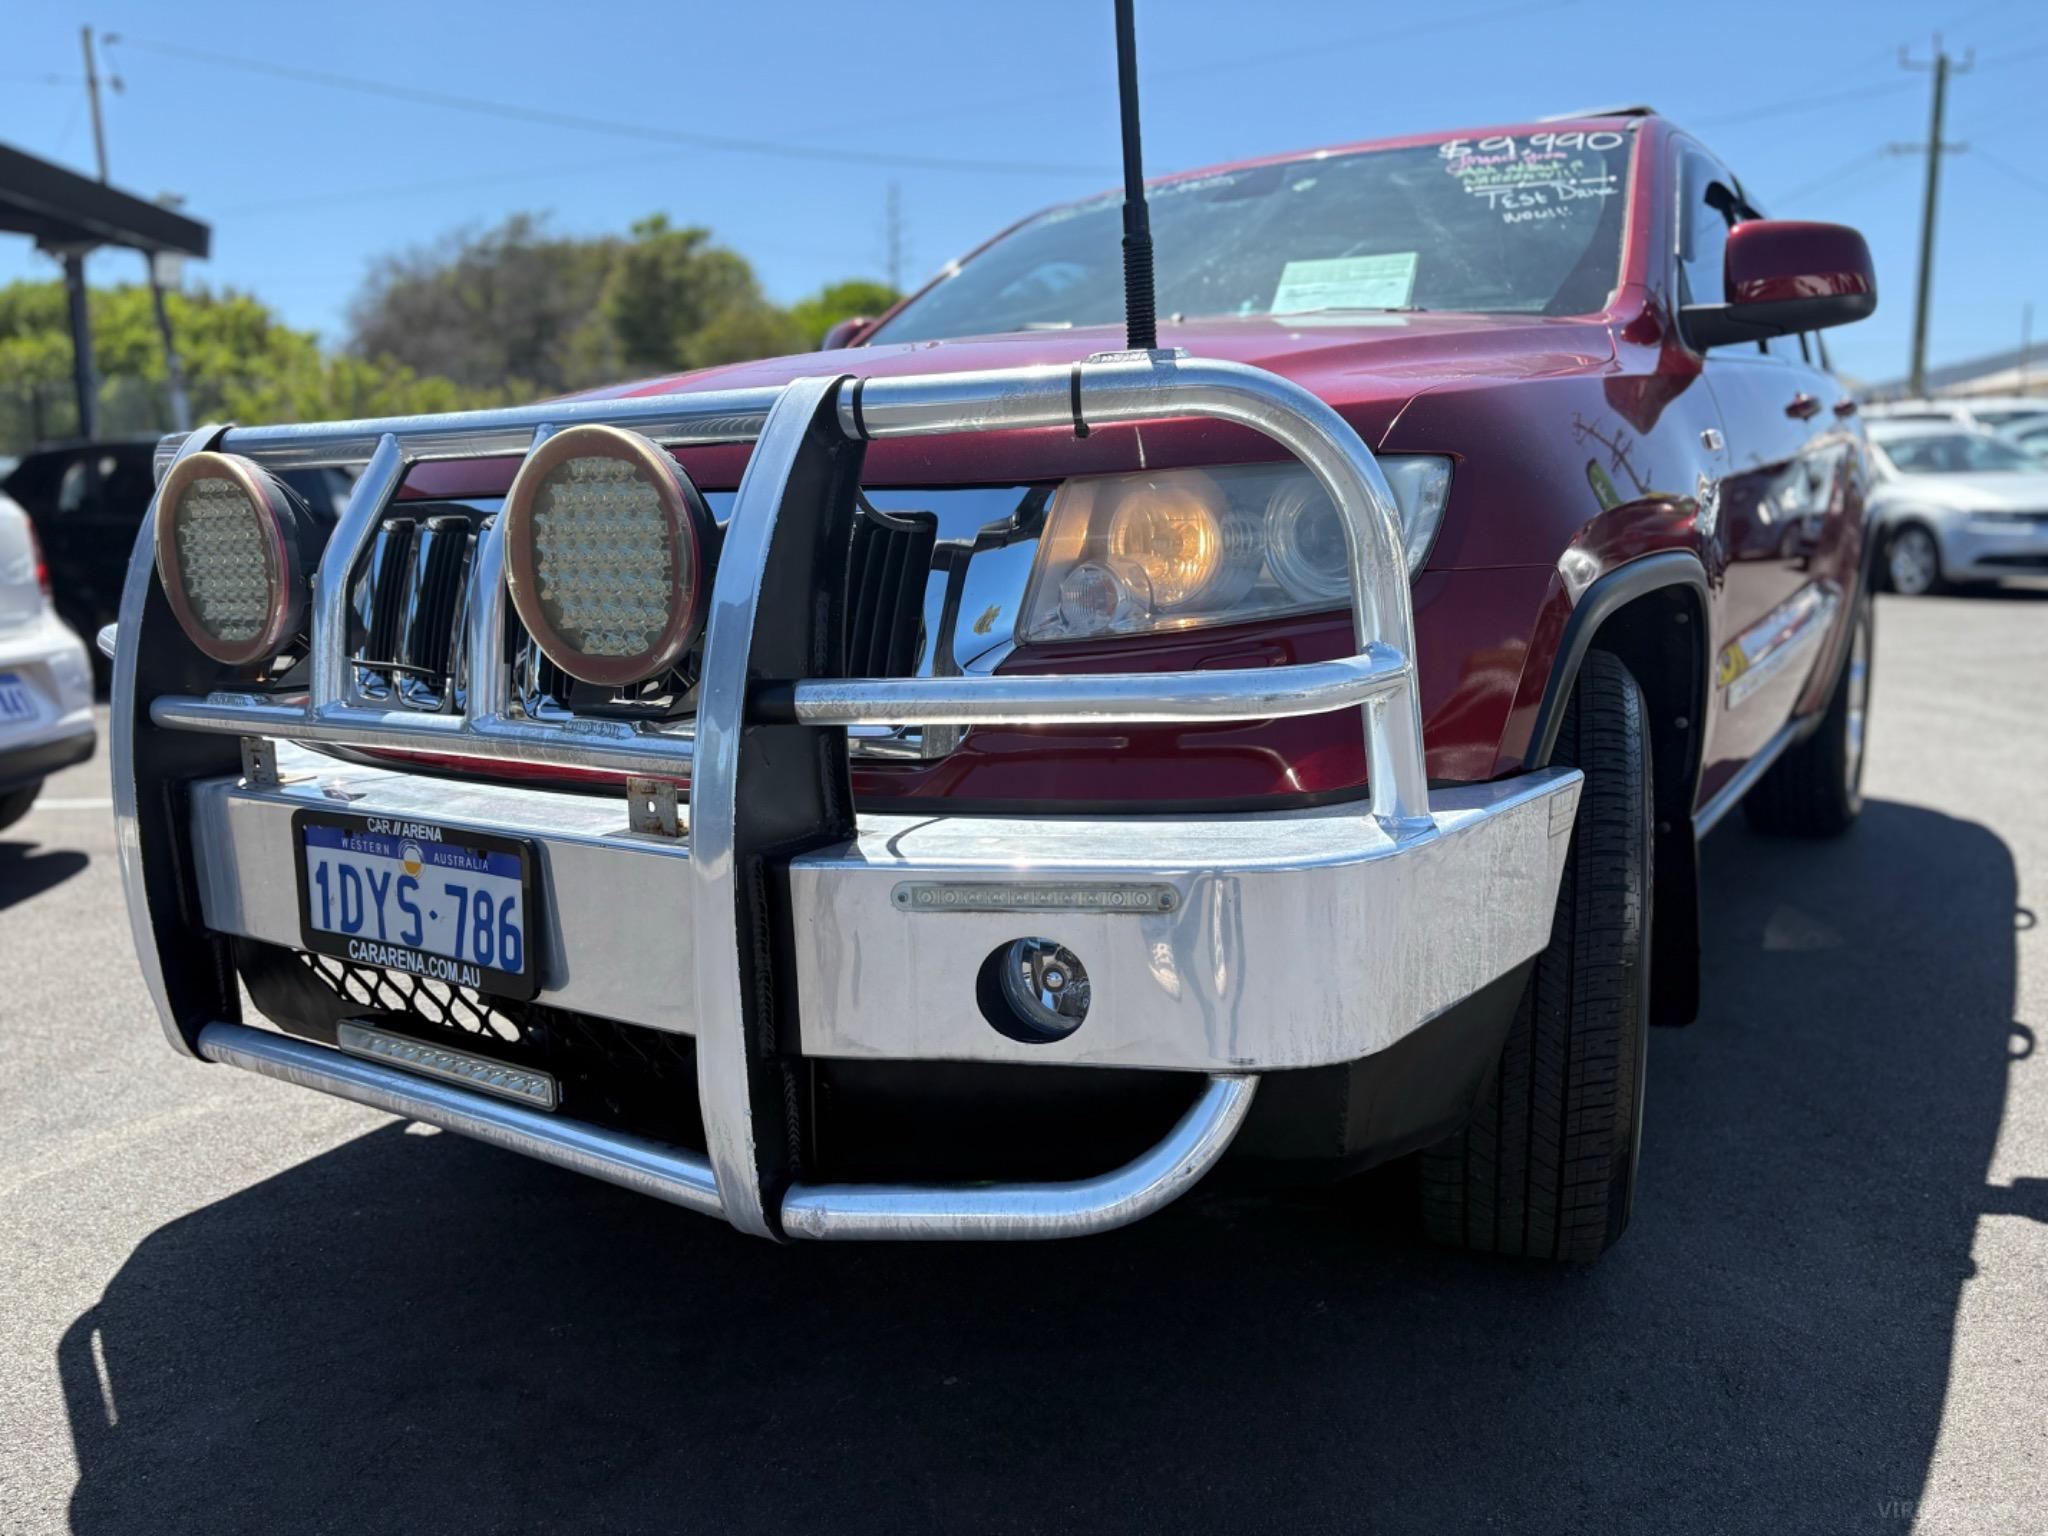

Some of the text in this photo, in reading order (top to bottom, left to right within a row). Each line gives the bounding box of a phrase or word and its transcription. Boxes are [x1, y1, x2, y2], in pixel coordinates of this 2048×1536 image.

[341, 837, 489, 872] WESTERN AUSTRALIA
[349, 939, 481, 989] CARARENA.COM.AU
